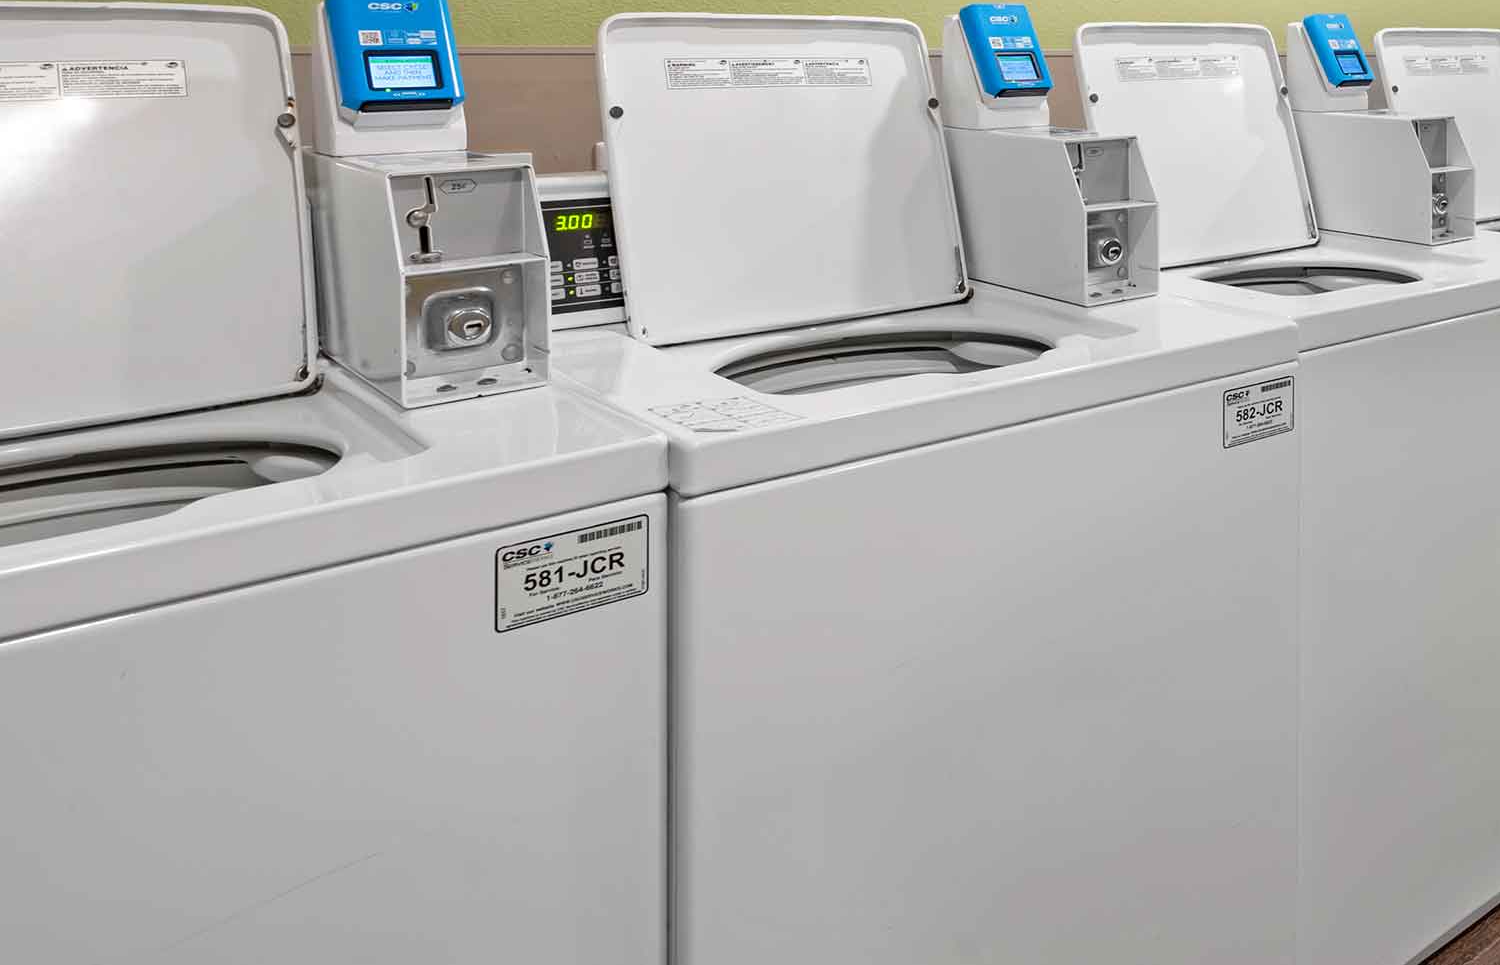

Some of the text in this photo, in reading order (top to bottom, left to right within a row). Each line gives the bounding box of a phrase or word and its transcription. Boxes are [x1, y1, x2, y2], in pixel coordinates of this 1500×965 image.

[368, 2, 402, 11] CSC
[555, 214, 593, 232] 3.00
[1226, 391, 1245, 402] CSC
[1236, 400, 1283, 423] 582-JCR
[502, 545, 541, 562] CSC
[523, 551, 625, 592] 581-JCR
